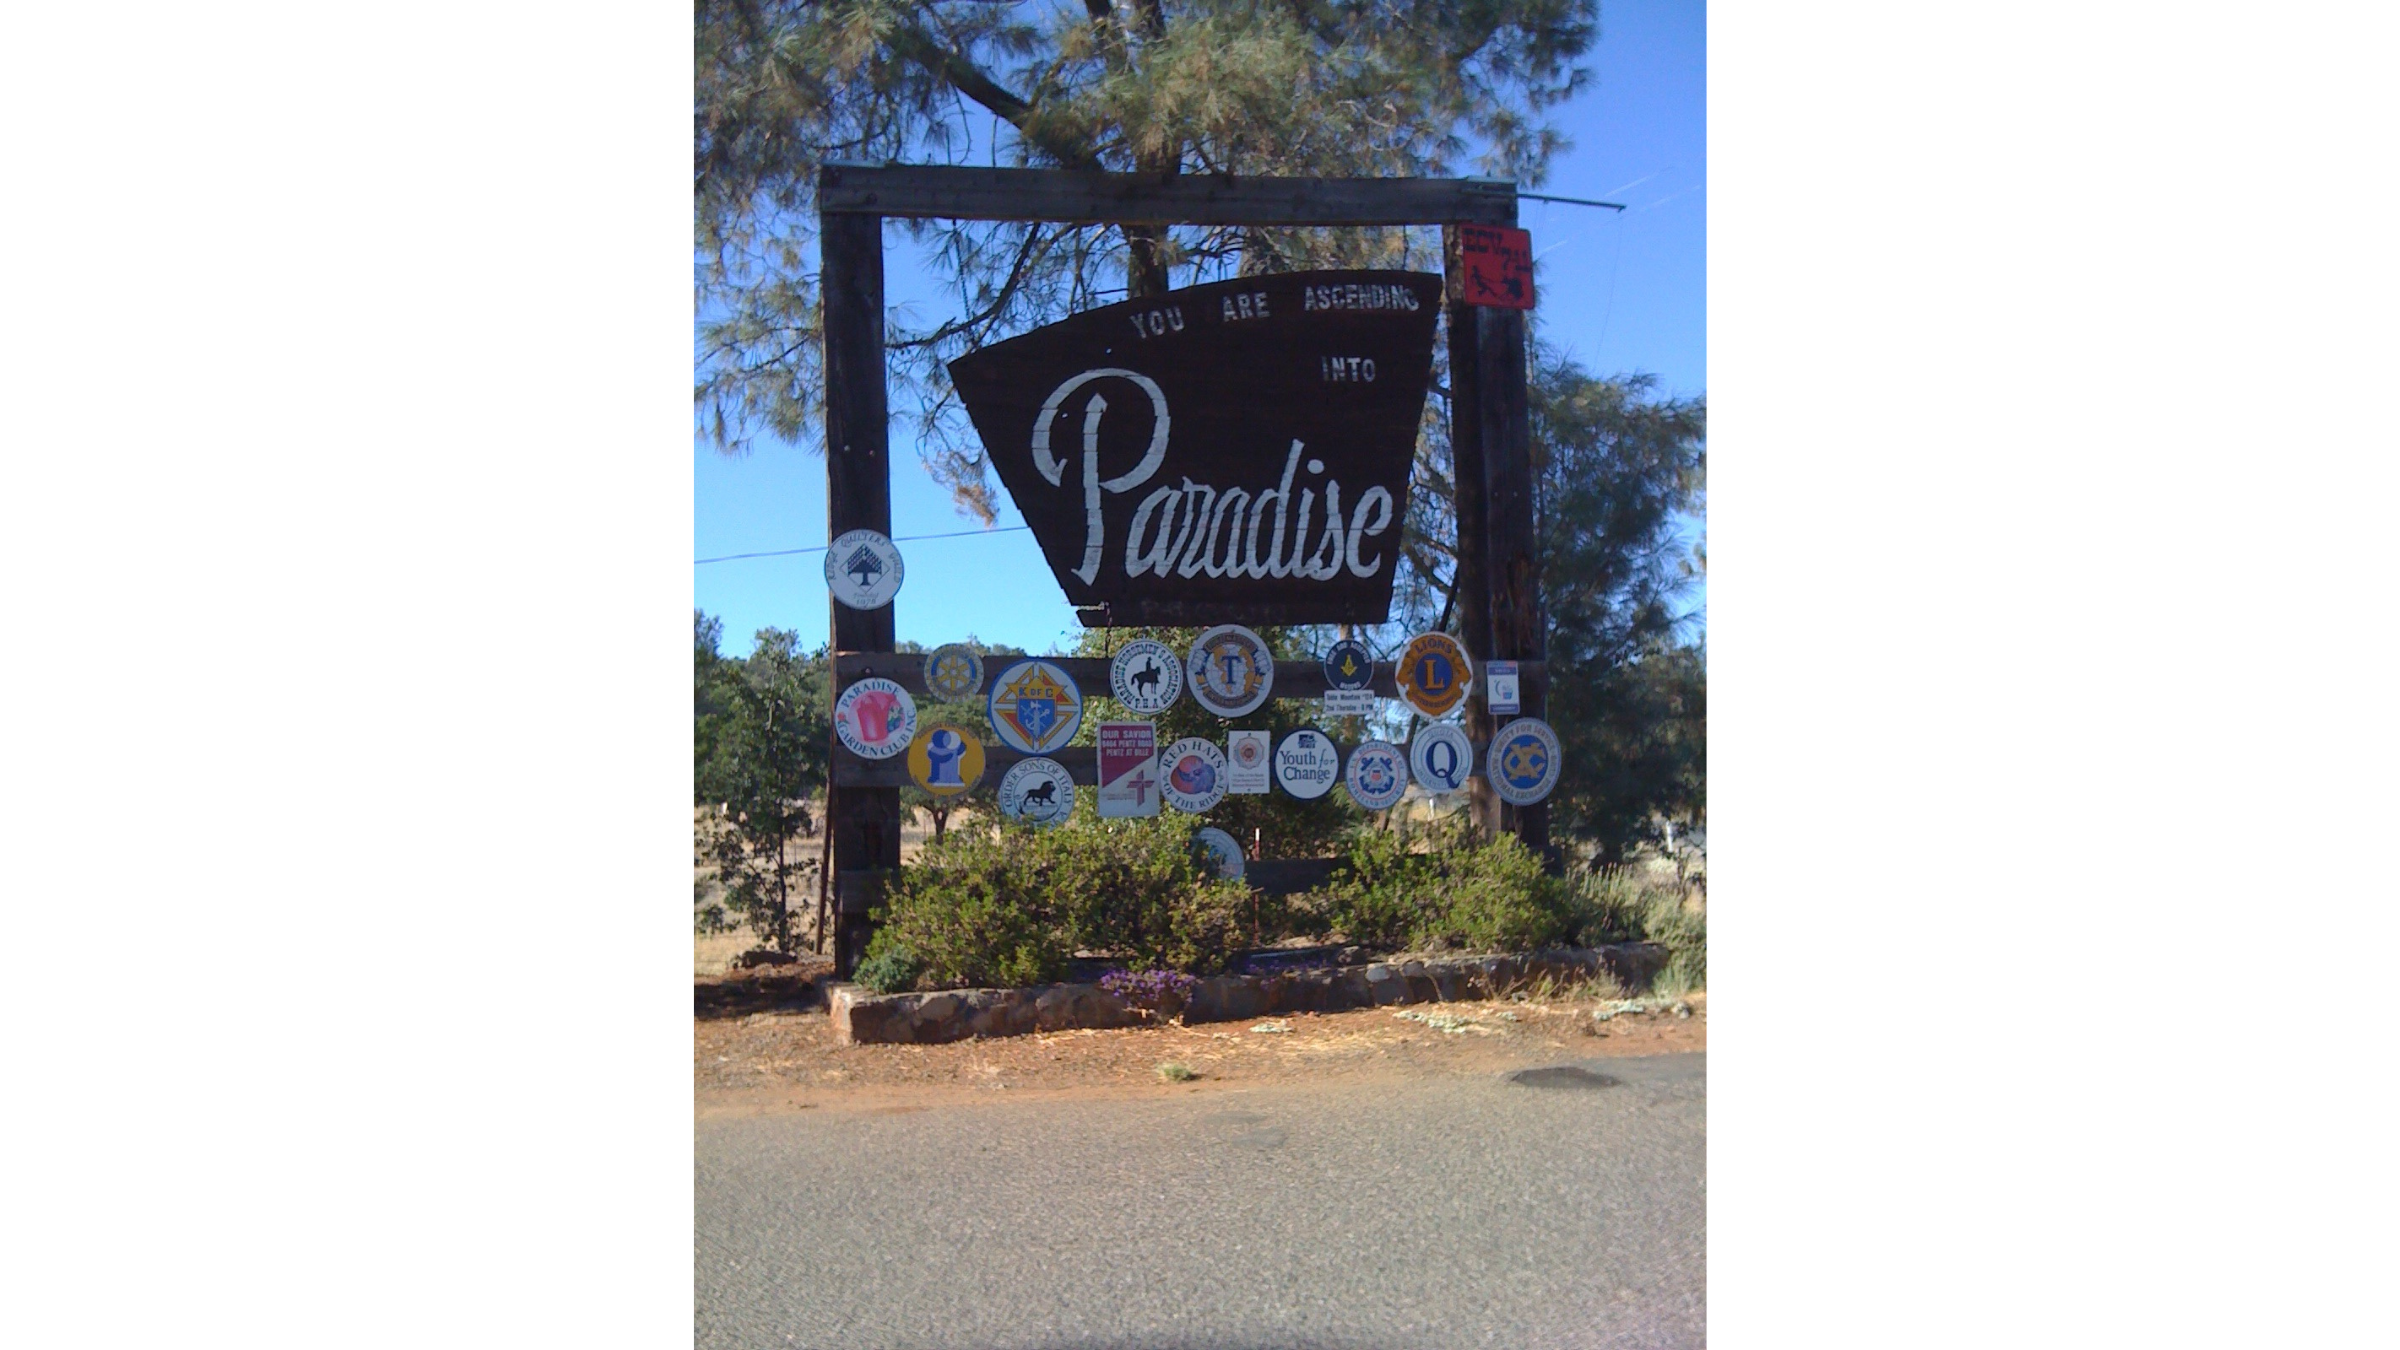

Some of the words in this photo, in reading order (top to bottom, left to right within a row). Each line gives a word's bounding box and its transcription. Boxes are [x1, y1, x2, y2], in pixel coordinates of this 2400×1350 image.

[1129, 305, 1185, 339] YOU
[1222, 292, 1271, 322] ARE
[1304, 284, 1420, 312] ASCENDING
[1321, 356, 1376, 382] INTO
[1031, 366, 1392, 586] Paradise
[841, 530, 886, 548] QUILTERS
[1414, 637, 1453, 653] LIONS
[1221, 655, 1242, 685] T
[1424, 660, 1445, 689] L
[841, 681, 900, 708] PARADISE
[1018, 686, 1028, 697] K
[1045, 688, 1054, 698] C
[1115, 665, 1136, 704] PARADISE
[837, 721, 878, 756] GARDEN
[880, 734, 910, 755] CLUB
[1102, 730, 1119, 739] OUR
[1123, 730, 1152, 739] SAVIOR
[1516, 723, 1532, 734] FOR
[1163, 743, 1187, 768] RED
[1192, 741, 1224, 769] HATS
[1279, 750, 1316, 765] Youth
[1318, 748, 1335, 769] for
[1426, 740, 1460, 789] Q
[1003, 772, 1019, 807] ORDER
[1019, 761, 1045, 775] SONS
[1047, 764, 1060, 775] OF
[1283, 766, 1331, 784] Change
[1163, 782, 1174, 795] OF
[1175, 795, 1195, 809] THE
[1199, 784, 1223, 808] RIDGE
